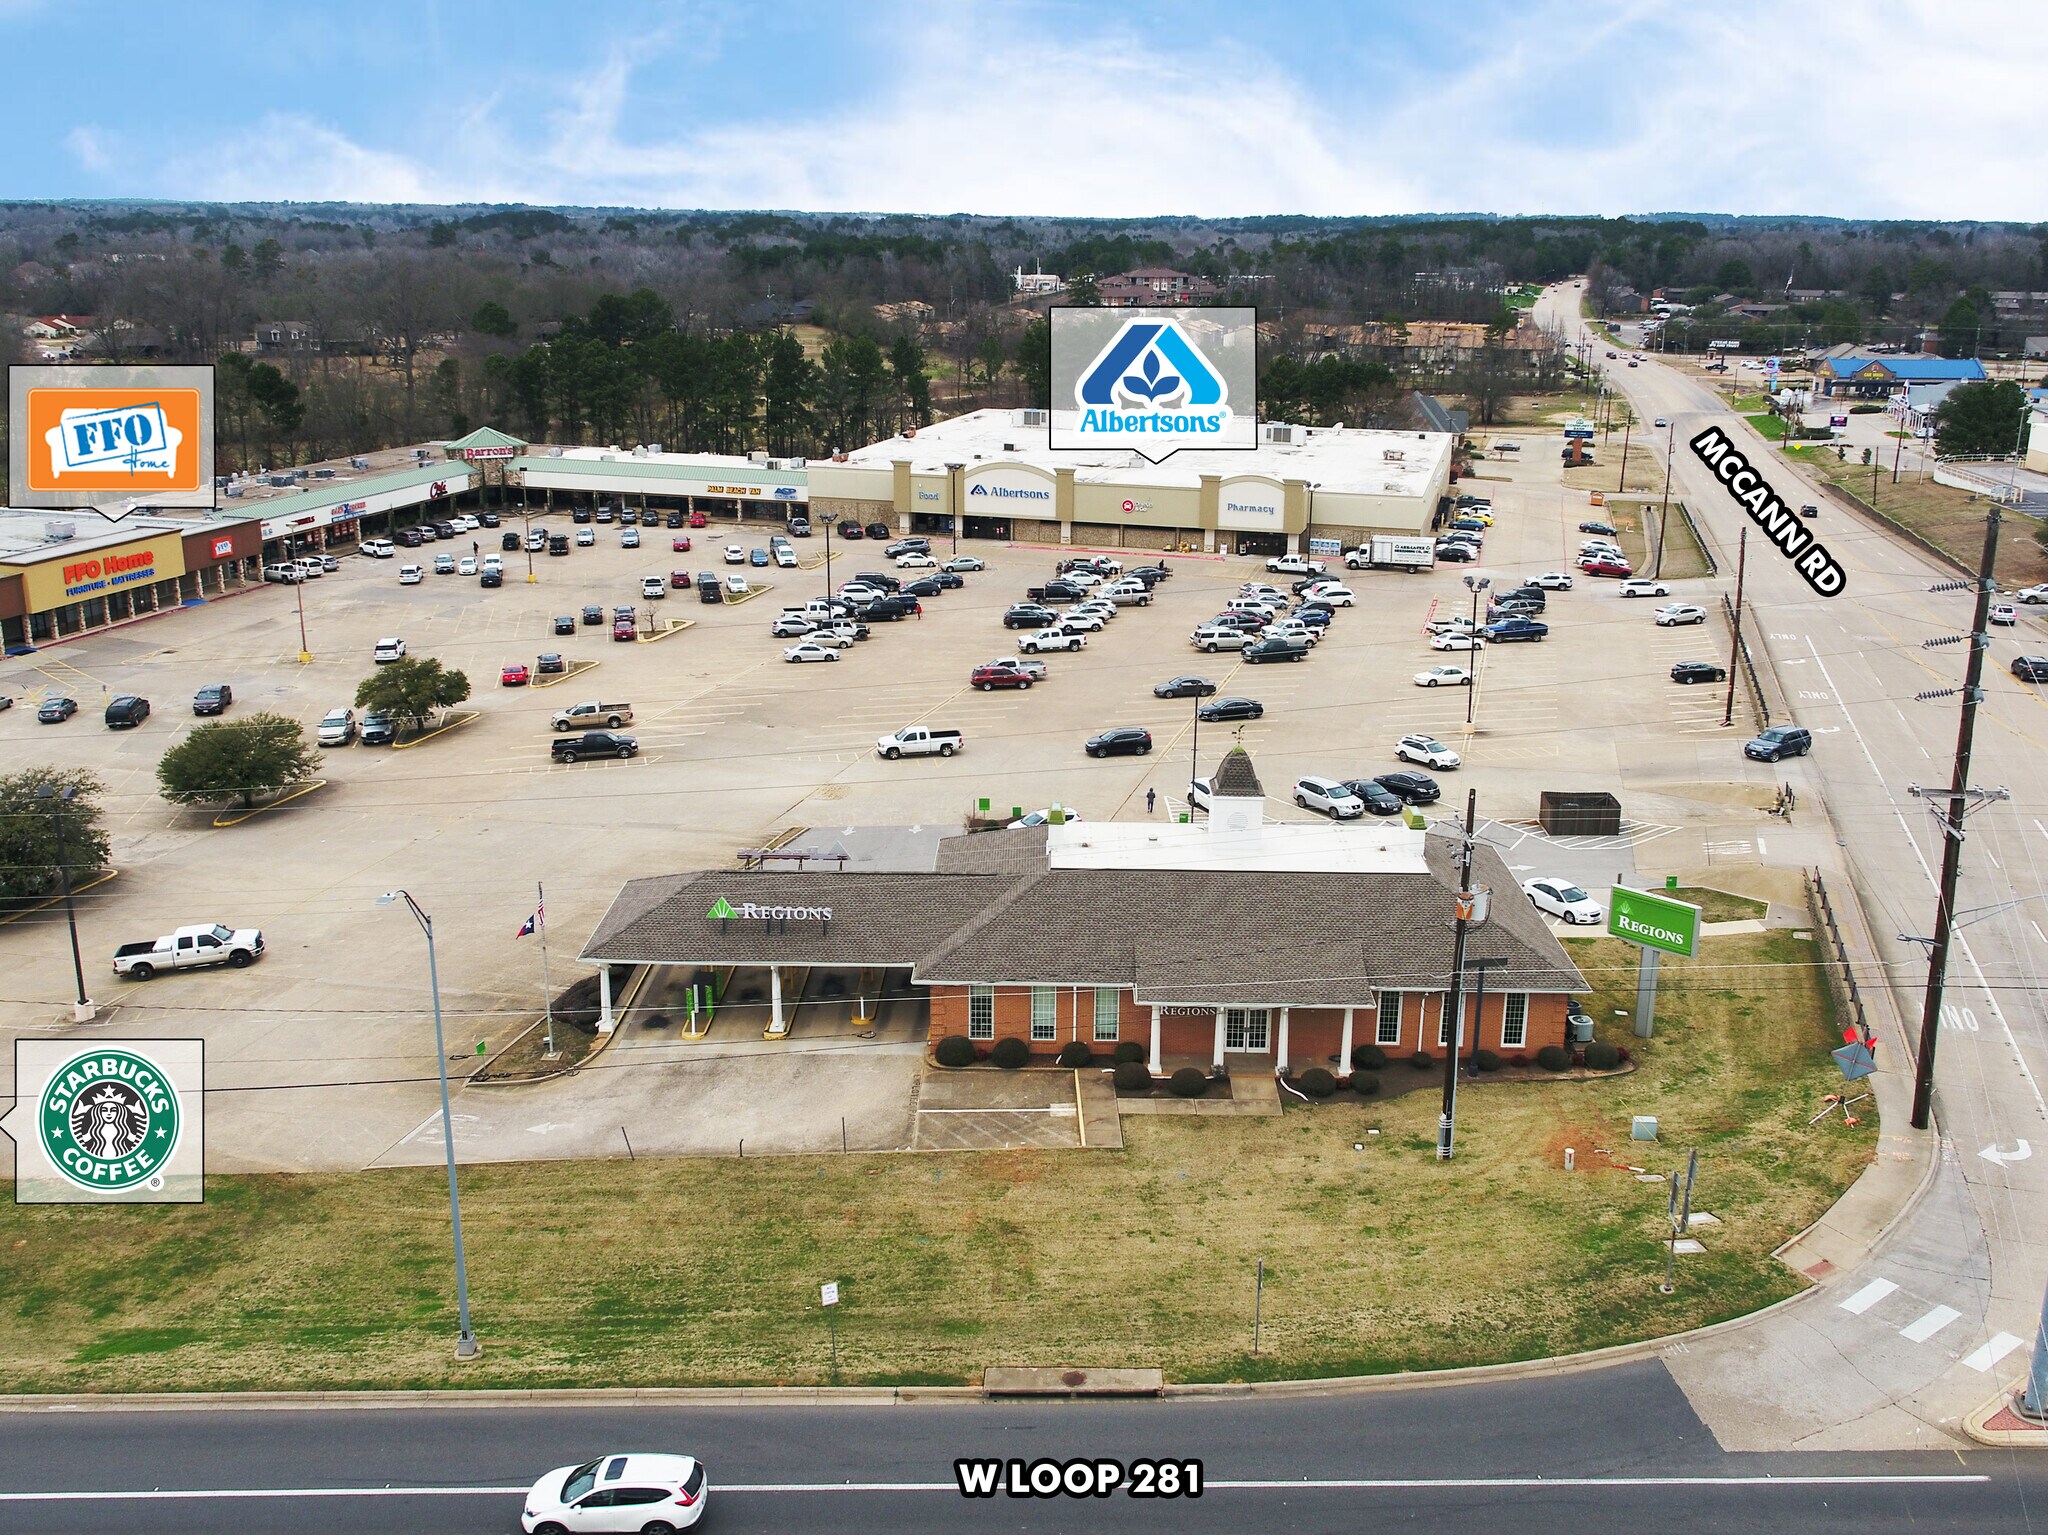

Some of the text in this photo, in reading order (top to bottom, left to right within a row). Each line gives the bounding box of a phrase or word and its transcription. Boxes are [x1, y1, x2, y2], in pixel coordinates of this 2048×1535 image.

[466, 447, 514, 459] Barron's
[707, 485, 761, 496] PALM BEACH TAN
[919, 491, 939, 501] Food
[990, 486, 1050, 500] Albertsons
[1227, 503, 1275, 515] Pharmacy
[63, 550, 154, 585] FFO Home
[66, 568, 155, 597] FURNITURE MATTRESSES
[1769, 632, 1797, 641] ONLY
[1798, 690, 1829, 700] ONLY
[743, 903, 833, 921] REGIONS
[1618, 915, 1684, 945] REGIONS
[1160, 1006, 1216, 1016] REGIONS
